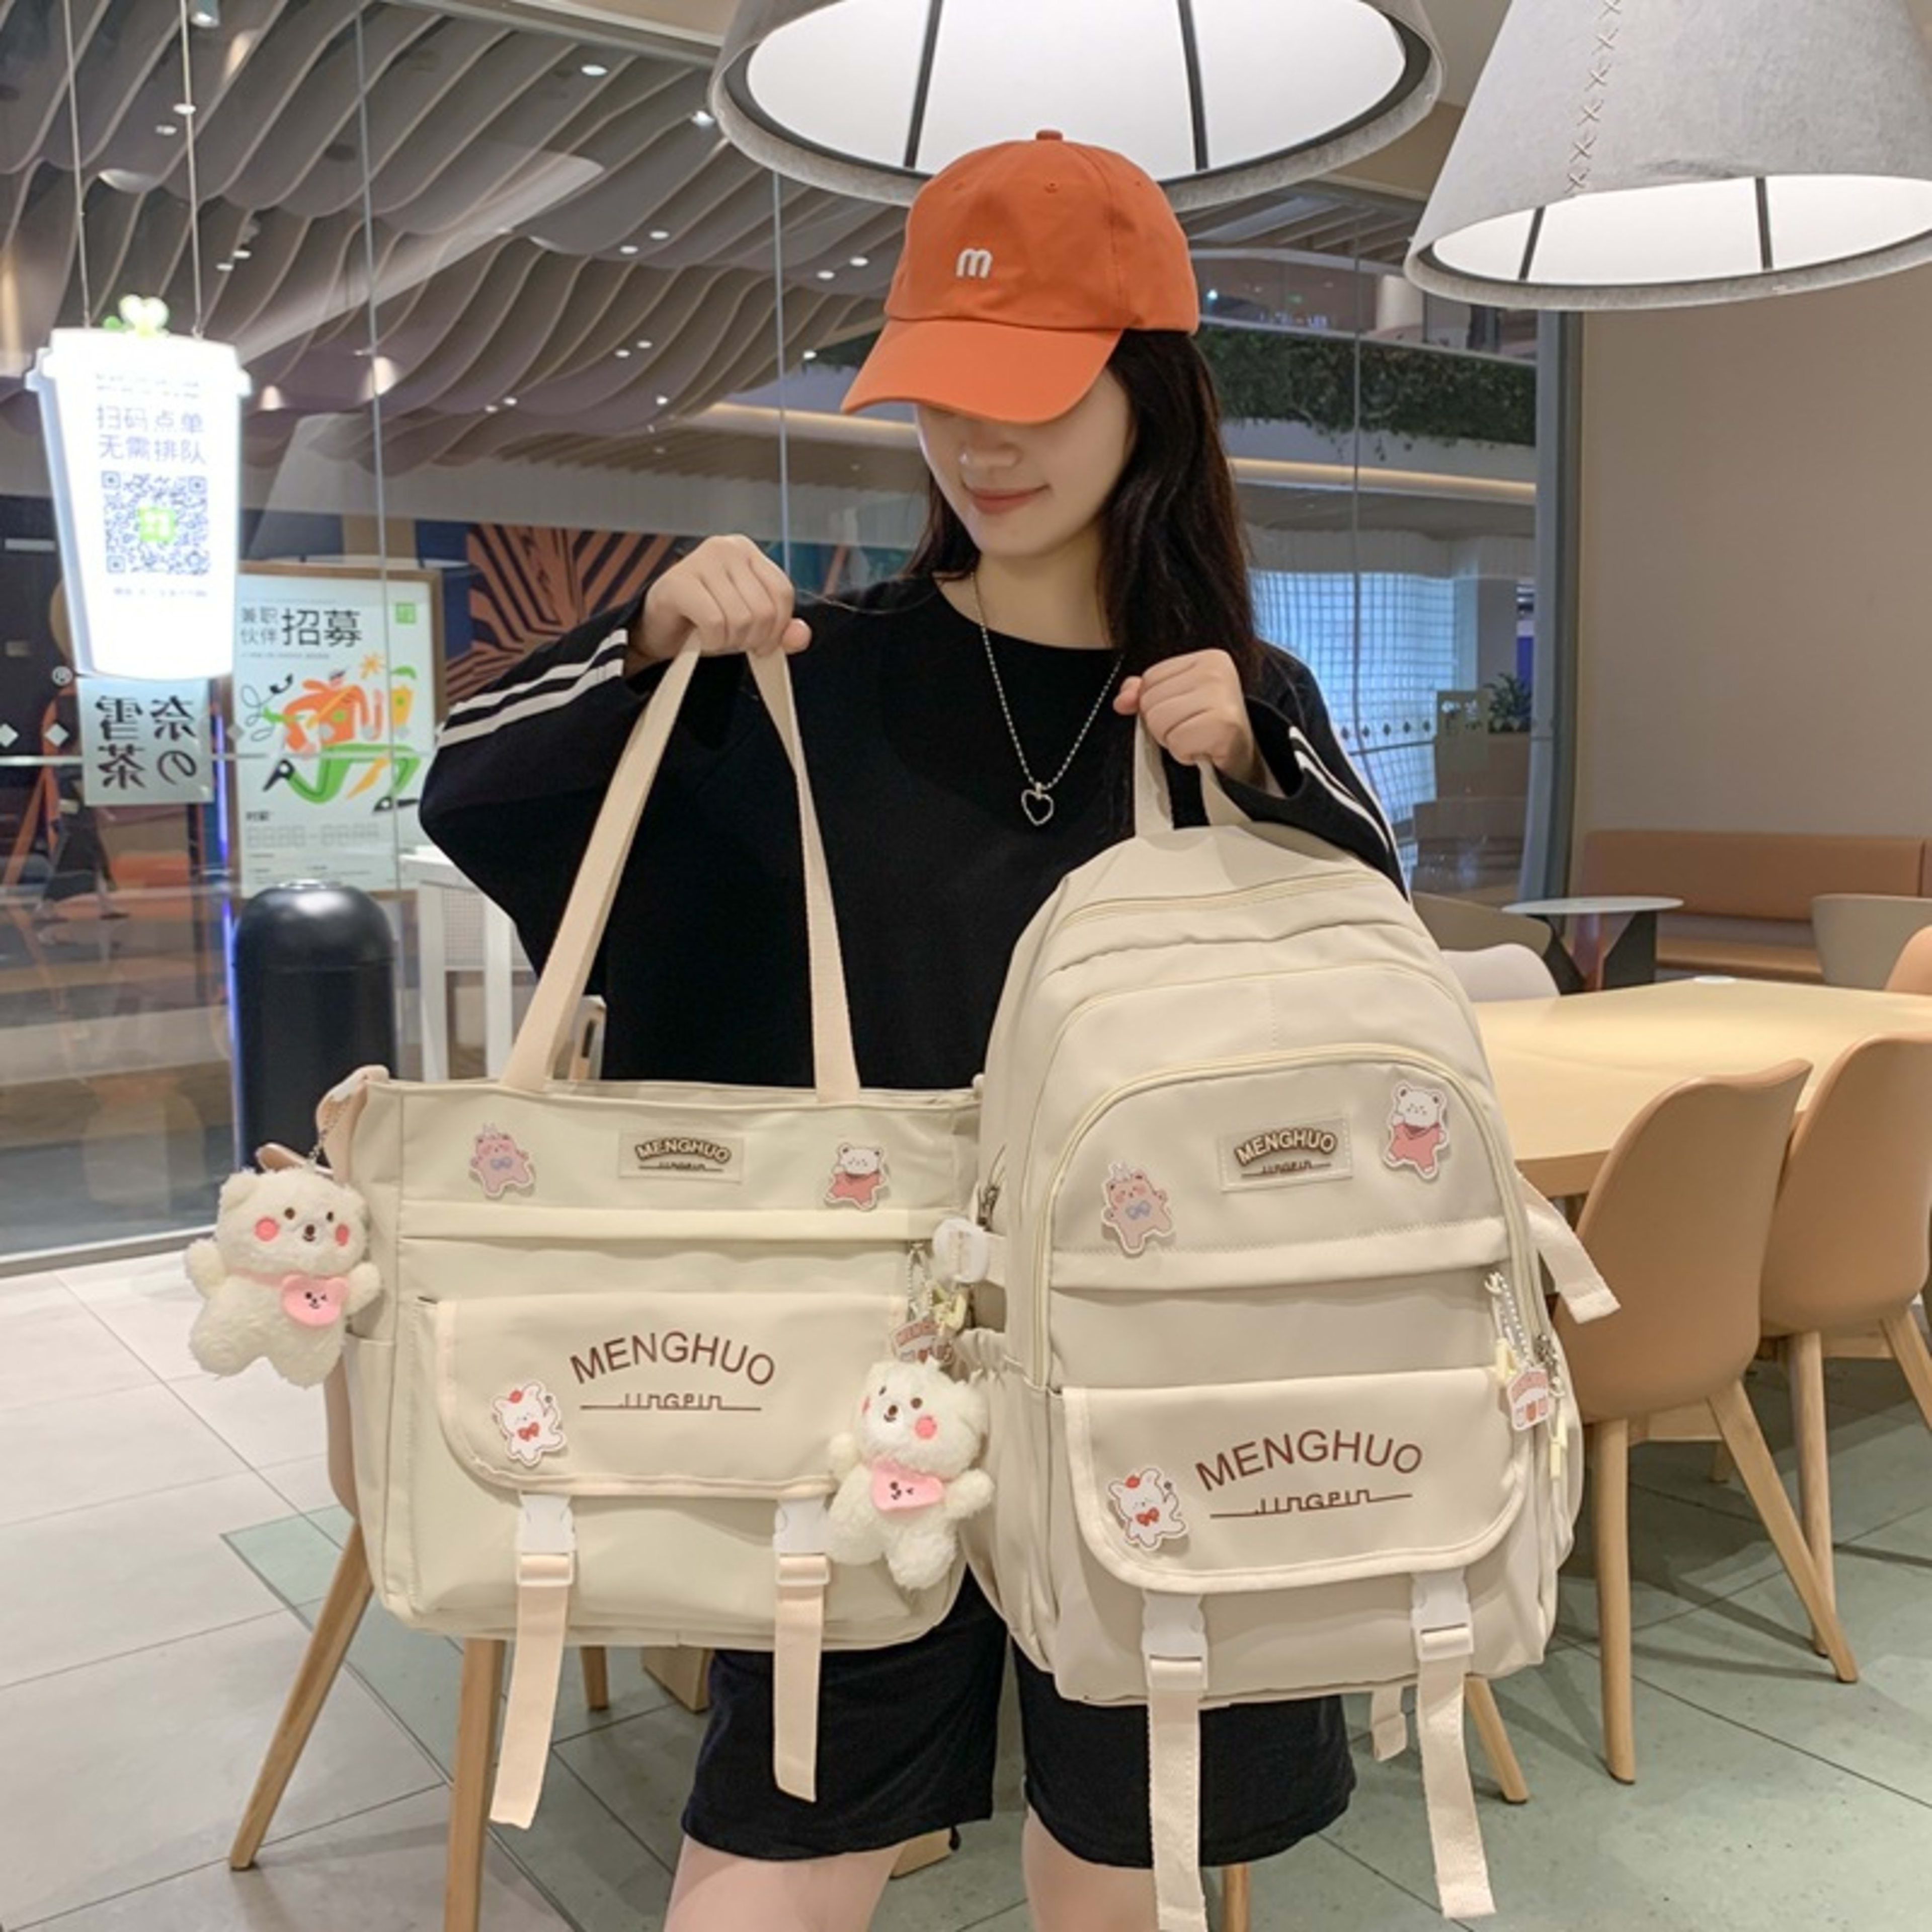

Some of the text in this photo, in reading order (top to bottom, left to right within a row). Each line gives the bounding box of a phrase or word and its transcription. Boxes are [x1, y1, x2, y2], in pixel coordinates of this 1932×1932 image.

[956, 248, 992, 278] m
[97, 404, 203, 434] 扫码点单
[99, 434, 207, 465] 无需排队
[282, 608, 363, 648] 招募
[635, 1137, 732, 1164] MENGHUO
[1234, 1128, 1337, 1167] MENGHUO
[570, 1331, 775, 1385] MENGHUO
[1195, 1429, 1423, 1492] MENGHUO
